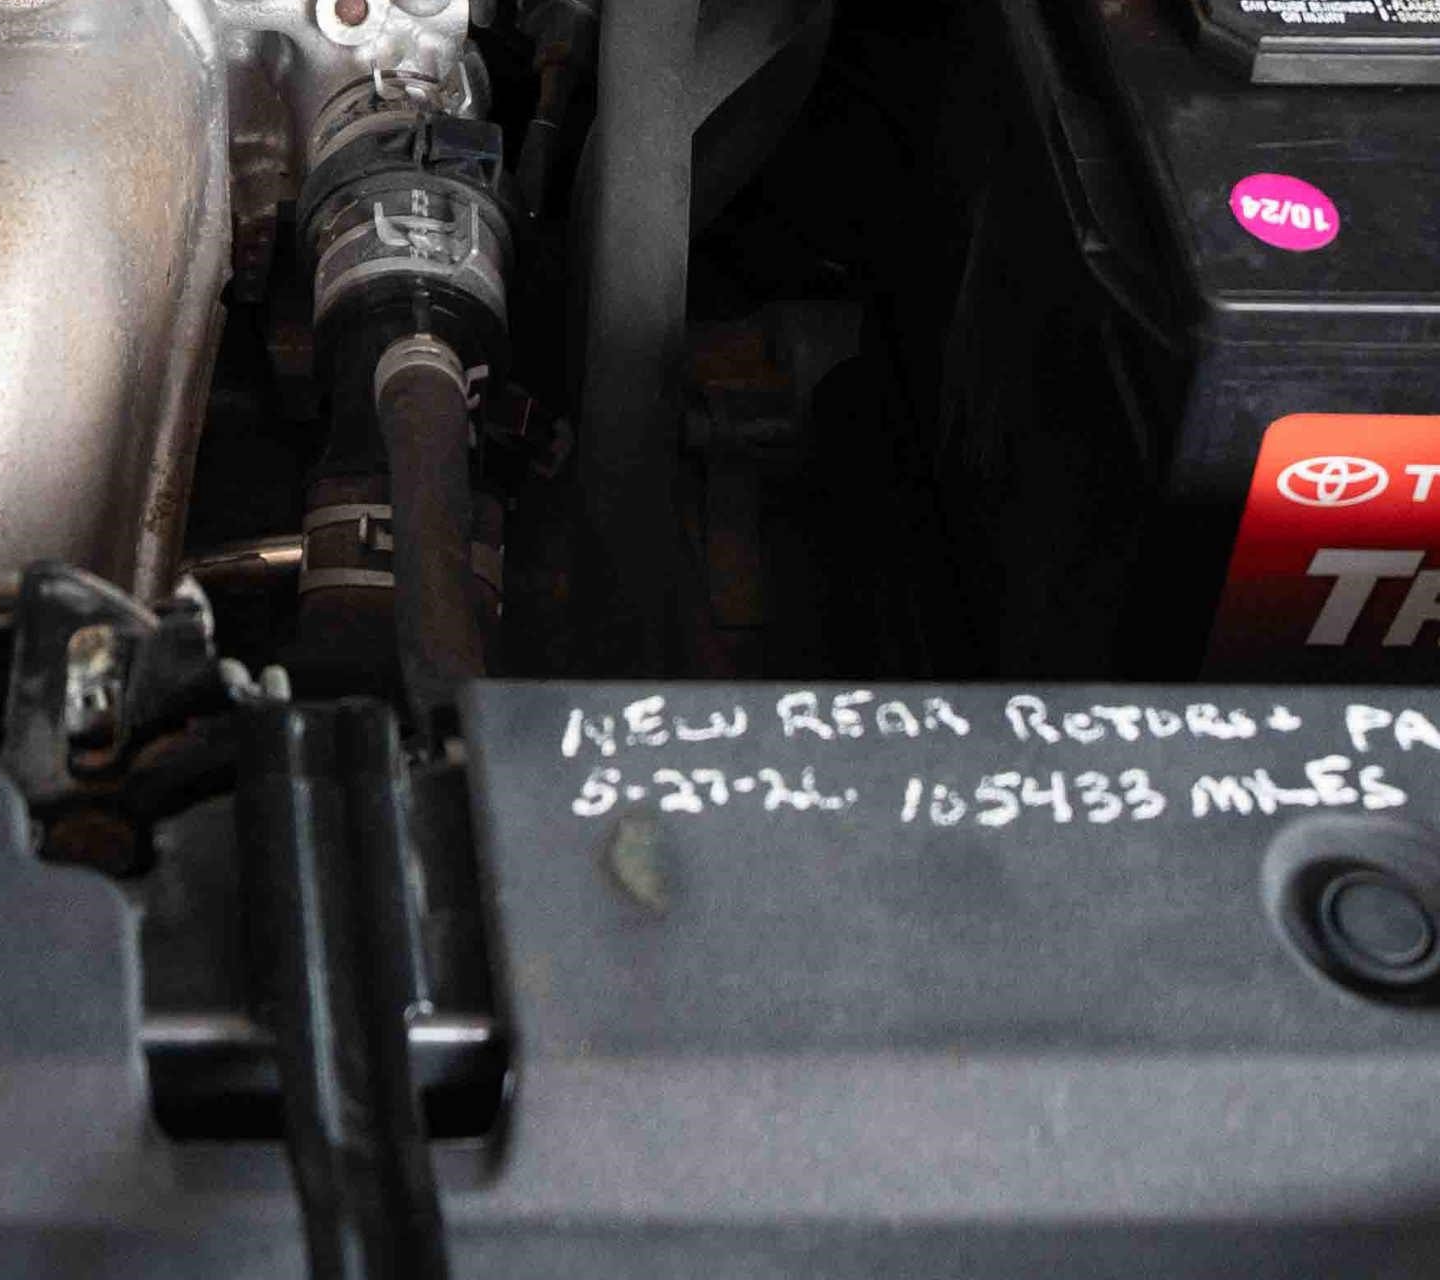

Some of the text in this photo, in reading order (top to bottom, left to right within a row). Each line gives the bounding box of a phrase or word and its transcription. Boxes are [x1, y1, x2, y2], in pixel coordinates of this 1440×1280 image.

[1240, 195, 1331, 232] 10/24
[562, 695, 748, 757] NEW
[776, 689, 970, 740] REAR
[901, 768, 1167, 827] 105433
[1192, 755, 1407, 818] MILES
